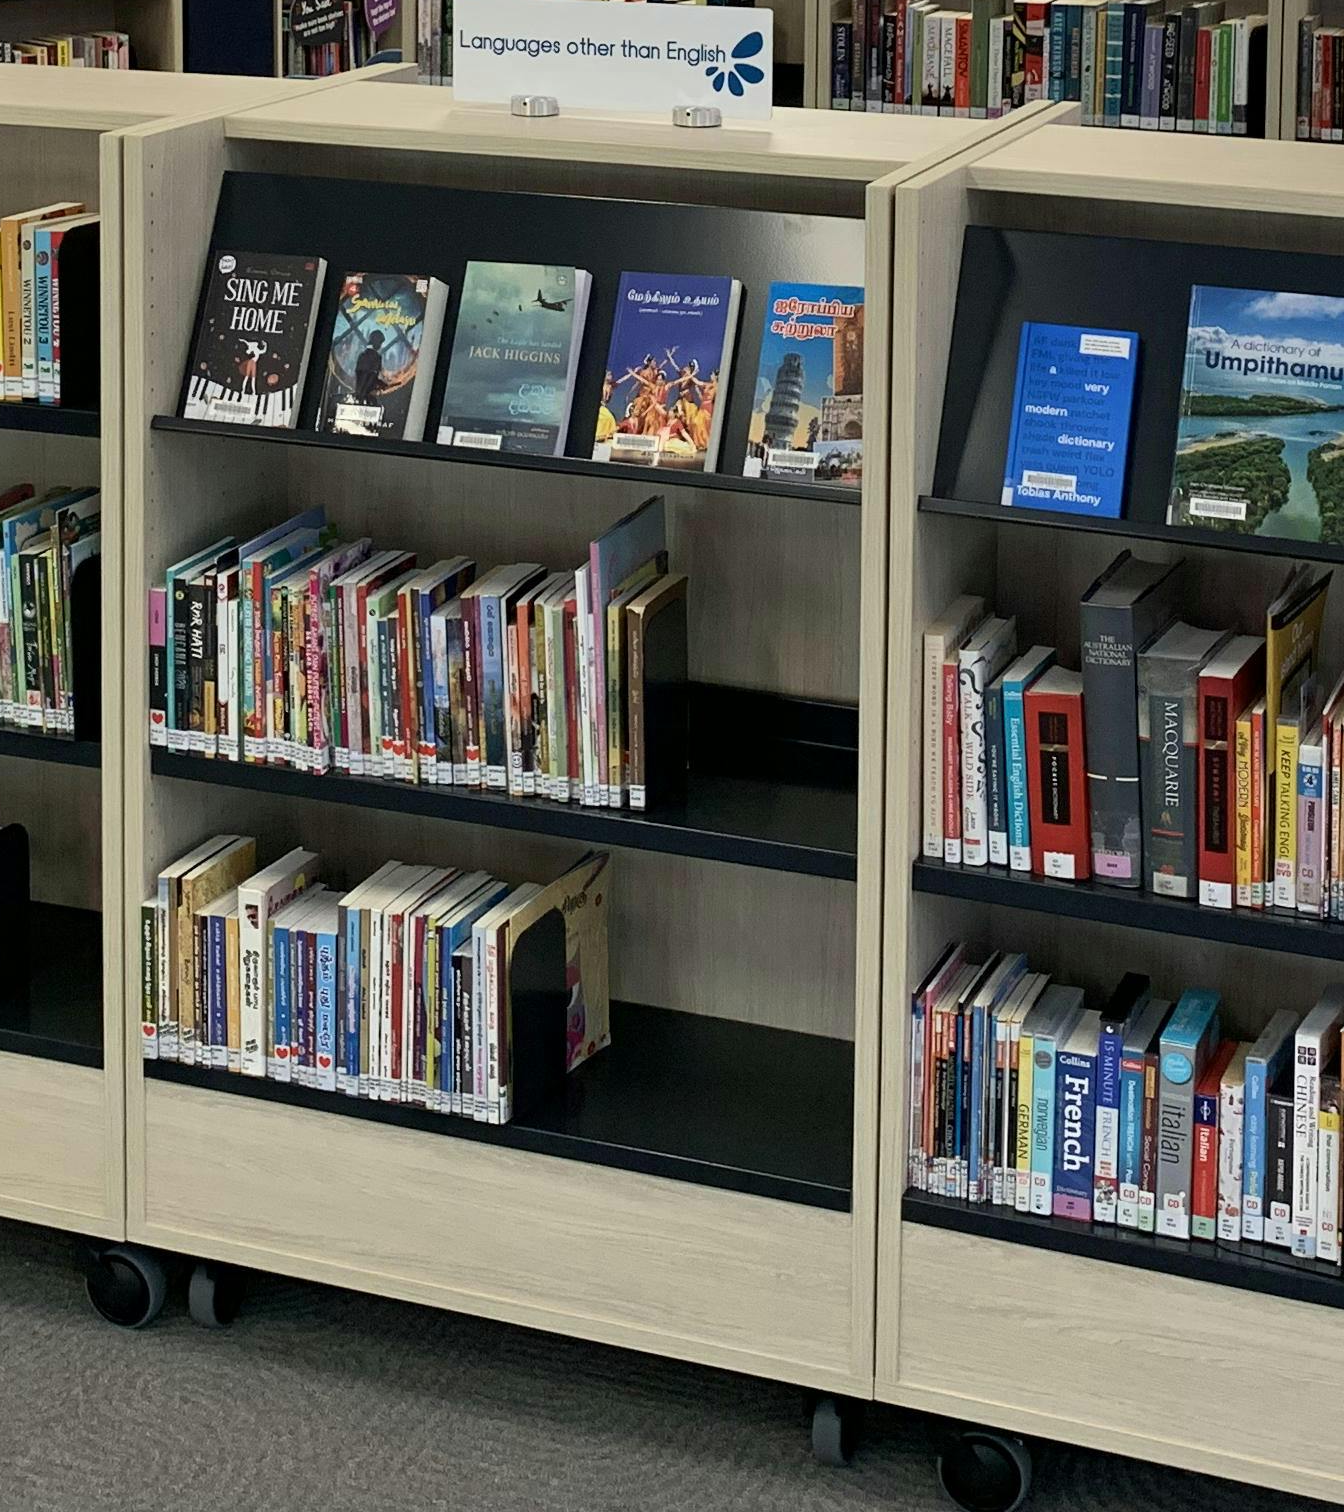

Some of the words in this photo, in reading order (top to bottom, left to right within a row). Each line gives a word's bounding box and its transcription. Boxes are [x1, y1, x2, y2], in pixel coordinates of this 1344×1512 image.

[1053, 12, 1065, 33] KATE
[460, 30, 560, 56] Languages
[567, 38, 615, 56] other
[621, 39, 661, 60] than
[667, 42, 726, 66] English
[835, 26, 846, 61] STOLEN
[943, 26, 953, 78] MAGEFALL
[958, 23, 969, 78] SIMANTOV
[1052, 35, 1065, 78] ATKINSON
[23, 278, 32, 334] WINNETOU
[38, 275, 49, 333] WINNETOU
[224, 278, 269, 304] SING
[271, 282, 303, 307] ME
[230, 307, 286, 334] HOME
[469, 345, 502, 359] JACK
[505, 348, 561, 364] HIGGINS
[1231, 339, 1241, 350] A
[1243, 341, 1304, 357] dictionary
[1308, 347, 1322, 357] of
[1049, 366, 1057, 375] a
[1206, 351, 1344, 382] Umpithamu
[1085, 383, 1110, 395] very
[1025, 404, 1068, 417] modern
[1057, 434, 1115, 451] dictionary
[1017, 485, 1050, 499] Tobias
[1053, 489, 1101, 506] Anthony
[190, 627, 203, 659] HATI
[1083, 641, 1133, 652] AUSTRALIAN
[1099, 635, 1115, 643] THE
[1085, 656, 1131, 667] DICTIONARY
[1088, 649, 1127, 659] NATIONAL
[964, 691, 972, 720] TALK
[1009, 718, 1021, 762] Essential
[1162, 702, 1179, 807] MACQUARIE
[966, 741, 974, 771] WILD
[1281, 749, 1291, 779] KEEP
[965, 773, 974, 800] SIDE
[1009, 764, 1023, 801] English
[1237, 761, 1249, 808] MODERN
[1279, 782, 1291, 826] TALKING
[1301, 867, 1314, 879] CD
[1059, 1055, 1091, 1068] Collins
[1309, 1076, 1317, 1104] Reading
[1296, 1074, 1307, 1136] CHINESE
[1017, 1104, 1030, 1160] GERMAN
[1033, 1097, 1049, 1151] norwegian
[1064, 1074, 1090, 1171] French
[1101, 1111, 1112, 1157] FRENCH
[1161, 1103, 1187, 1164] italian
[1199, 1127, 1211, 1162] Italian
[1035, 1176, 1045, 1186] CD
[1123, 1189, 1135, 1199] CD
[1140, 1195, 1151, 1205] CD
[1168, 1198, 1179, 1209] CD
[1247, 1200, 1258, 1210] CD
[1274, 1207, 1286, 1217] CD
[1322, 1221, 1333, 1232] CD
